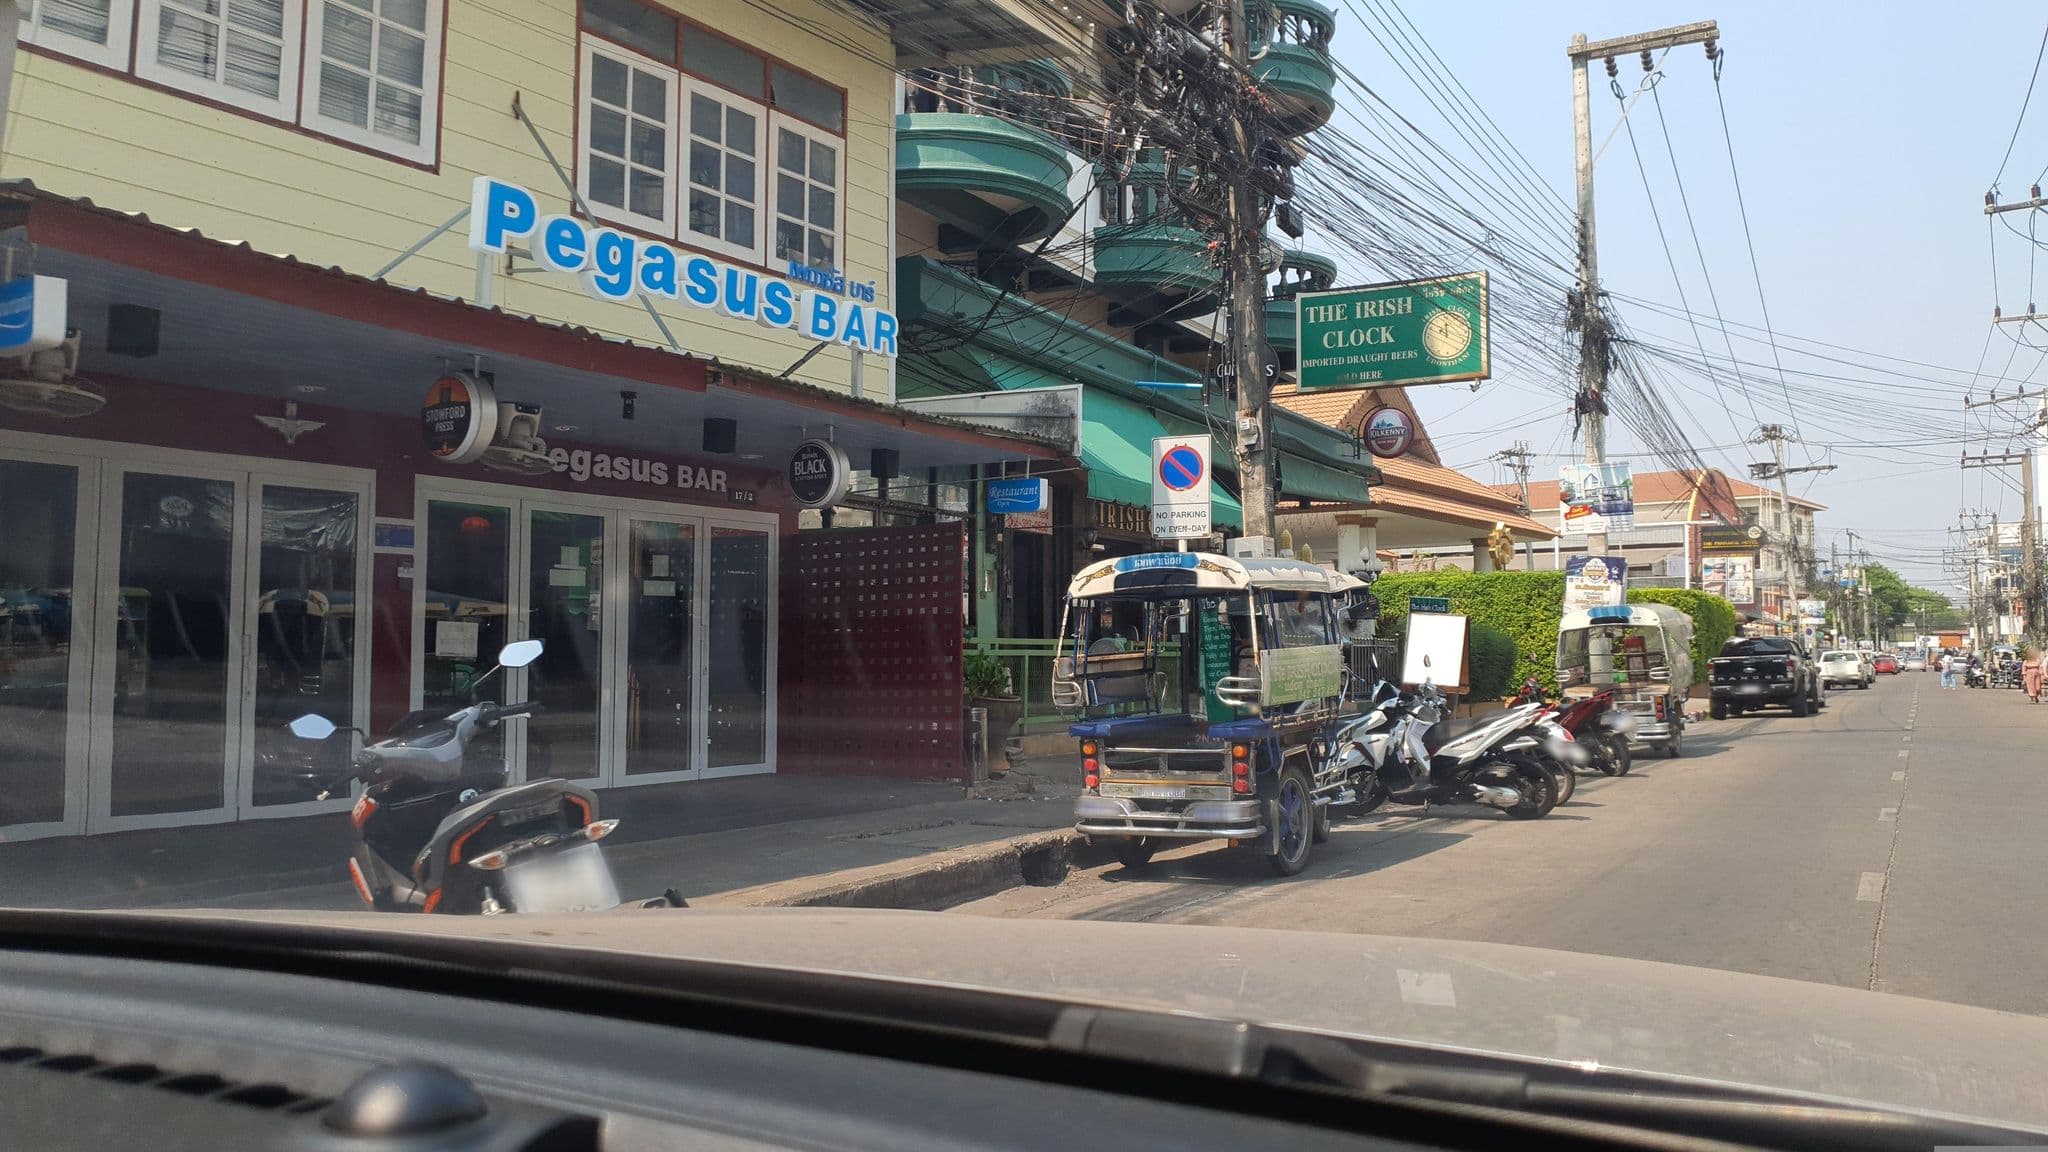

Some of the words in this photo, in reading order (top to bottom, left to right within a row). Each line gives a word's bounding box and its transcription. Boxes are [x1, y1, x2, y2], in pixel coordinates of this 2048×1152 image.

[484, 180, 794, 328] Pegasus
[810, 293, 898, 354] BAR
[1305, 303, 1348, 324] THE
[1355, 296, 1413, 319] IRISH
[1322, 326, 1396, 349] CLOCK
[1302, 356, 1345, 368] IMPORTED
[1346, 352, 1389, 364] DRAUGHT
[1391, 349, 1419, 360] BEERS
[1360, 370, 1384, 380] HERE
[425, 405, 466, 422] STOWFORD
[1370, 428, 1406, 439] KILKENNY
[549, 447, 669, 486] egasus
[677, 464, 728, 493] BAR
[794, 459, 827, 476] BLACK
[990, 486, 1039, 499] Restaurant
[1099, 502, 1145, 533] IRISH
[1156, 511, 1168, 519] NO
[1170, 510, 1207, 519] PARKING
[1155, 526, 1166, 534] ON
[1717, 674, 1785, 682] RANGER
